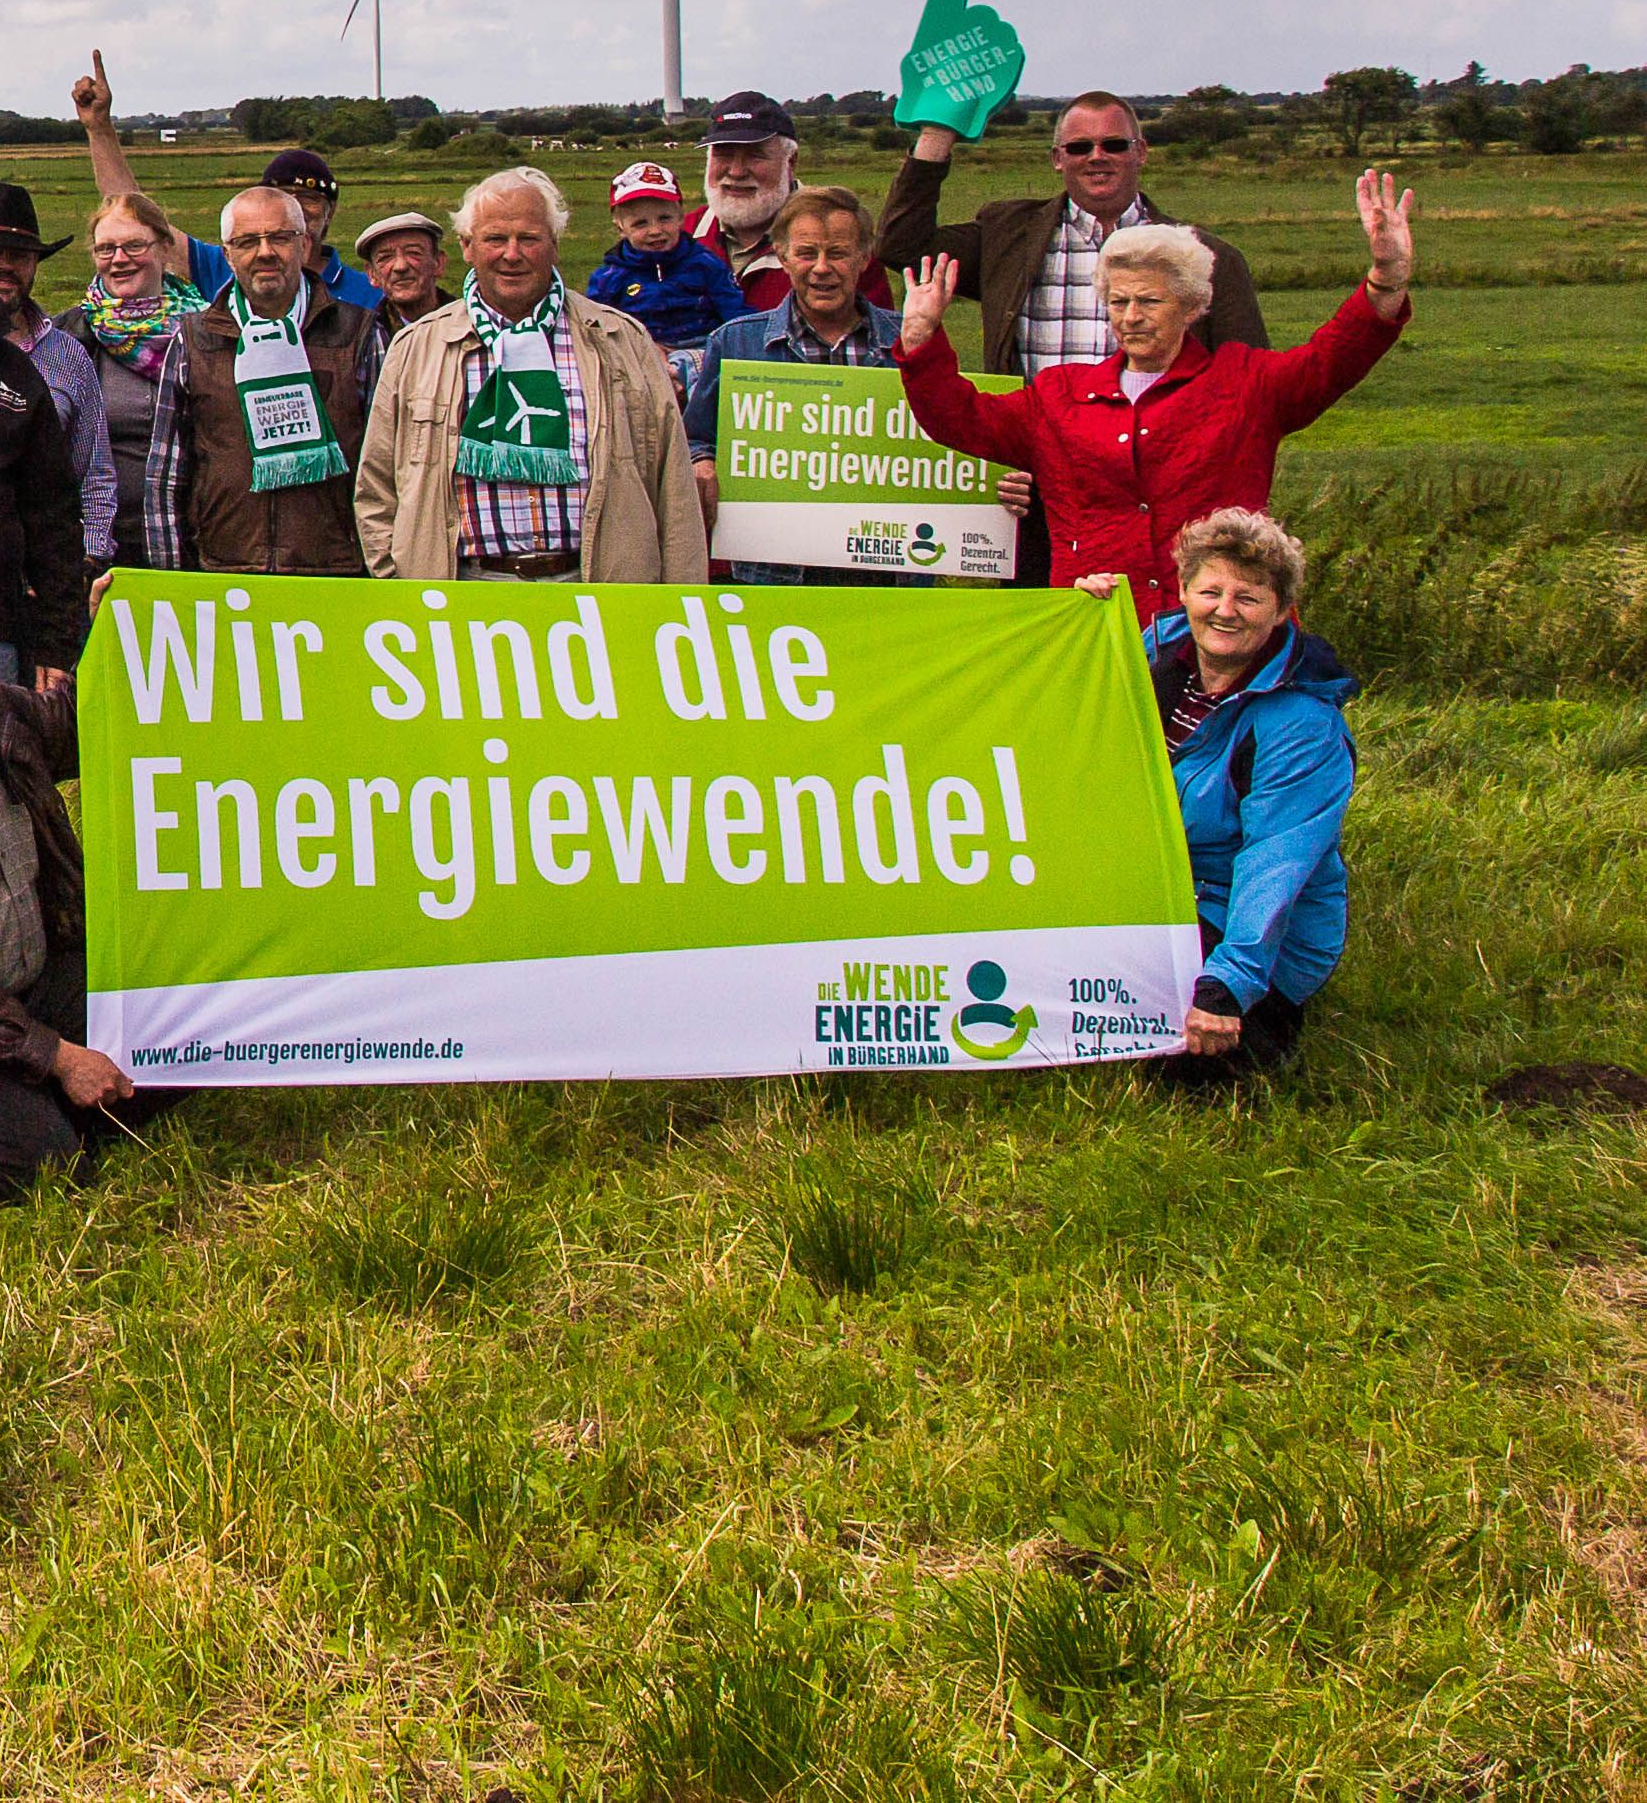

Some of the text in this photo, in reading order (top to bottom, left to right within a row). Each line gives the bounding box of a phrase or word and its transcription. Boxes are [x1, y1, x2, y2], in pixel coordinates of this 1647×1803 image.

[935, 45, 1016, 86] BÜRGER-
[946, 73, 996, 103] HAND
[256, 400, 306, 415] ENERGIE
[257, 408, 309, 427] WENDE
[731, 390, 932, 441] Wir sind di
[262, 421, 312, 440] JETZT!
[730, 439, 987, 494] Energiewende!
[860, 520, 908, 539] WENDE
[961, 532, 993, 545] 100%.
[960, 546, 1009, 560] Dezentral.
[960, 560, 1001, 574] Gerecht.
[111, 588, 836, 724] Wir sind die
[131, 738, 1037, 920] Energiewende!
[843, 961, 950, 1002] WENDE
[1068, 977, 1137, 1004] 100%.
[1072, 1010, 1177, 1036] Dezentral.
[131, 1038, 464, 1066] www.die-buergerenergiewende.de
[828, 1046, 844, 1065] IN
